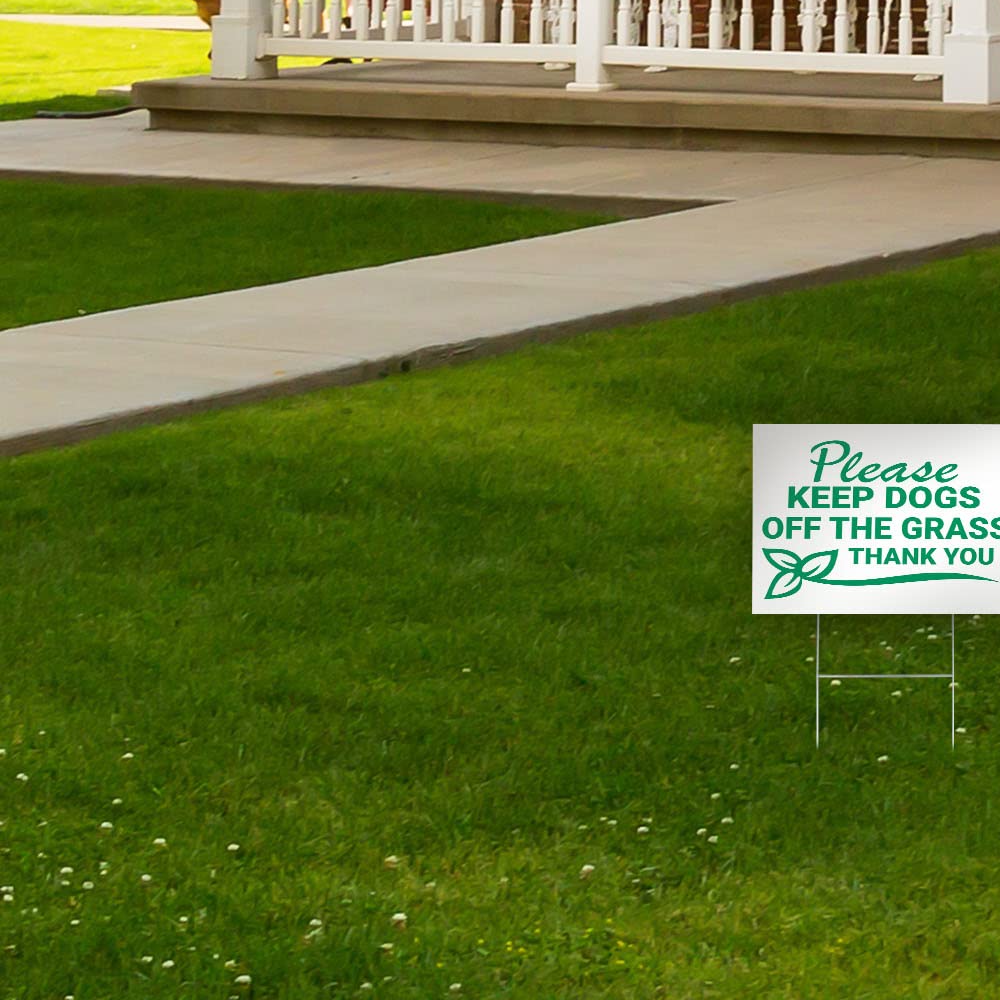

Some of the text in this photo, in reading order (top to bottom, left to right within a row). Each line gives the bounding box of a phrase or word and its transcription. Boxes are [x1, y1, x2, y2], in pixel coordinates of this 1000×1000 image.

[810, 439, 959, 483] Please
[787, 486, 981, 509] KEEP DOGS
[761, 516, 822, 540] OFF
[829, 516, 893, 540] THE
[848, 547, 995, 566] THANK YOU
